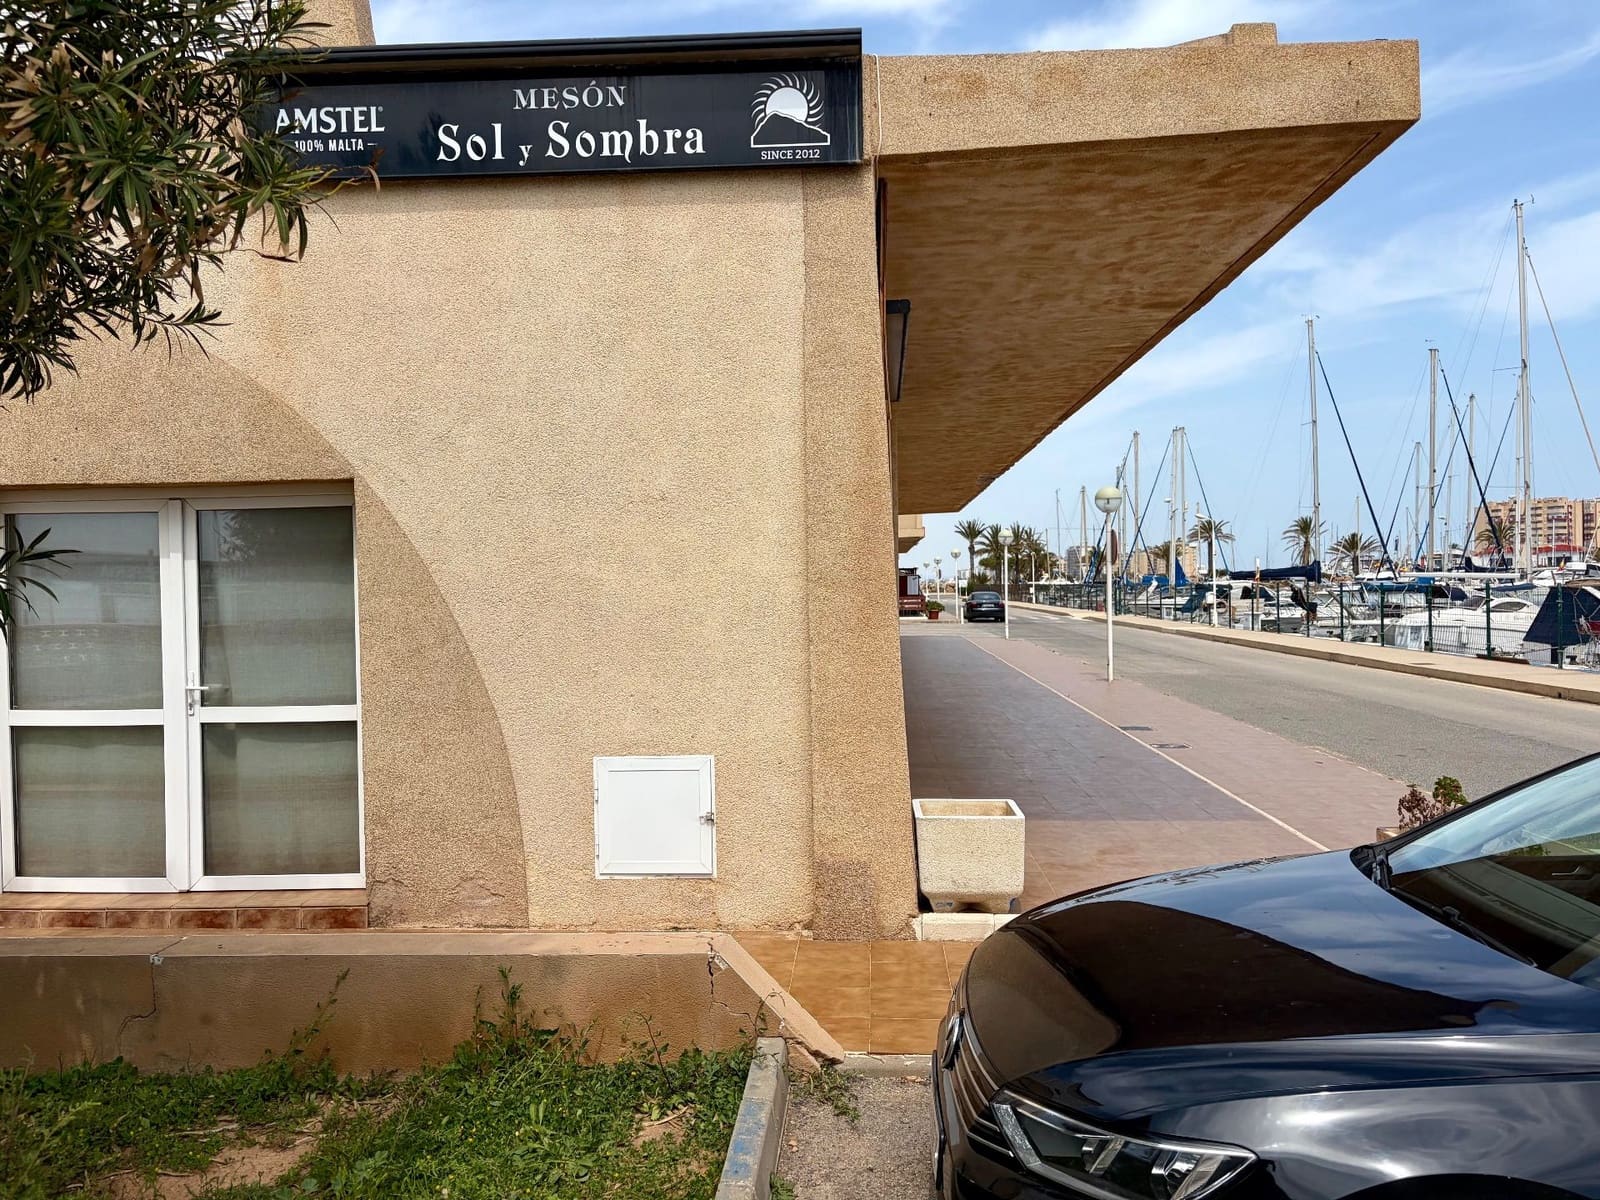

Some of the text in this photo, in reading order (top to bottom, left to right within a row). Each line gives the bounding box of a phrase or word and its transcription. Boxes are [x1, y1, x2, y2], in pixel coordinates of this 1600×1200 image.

[513, 80, 627, 110] MESÓN
[275, 106, 385, 135] AMSTEL
[328, 138, 364, 152] MALTA
[436, 118, 707, 167] Sol y Sombra
[760, 149, 821, 160] SINCE 2012
